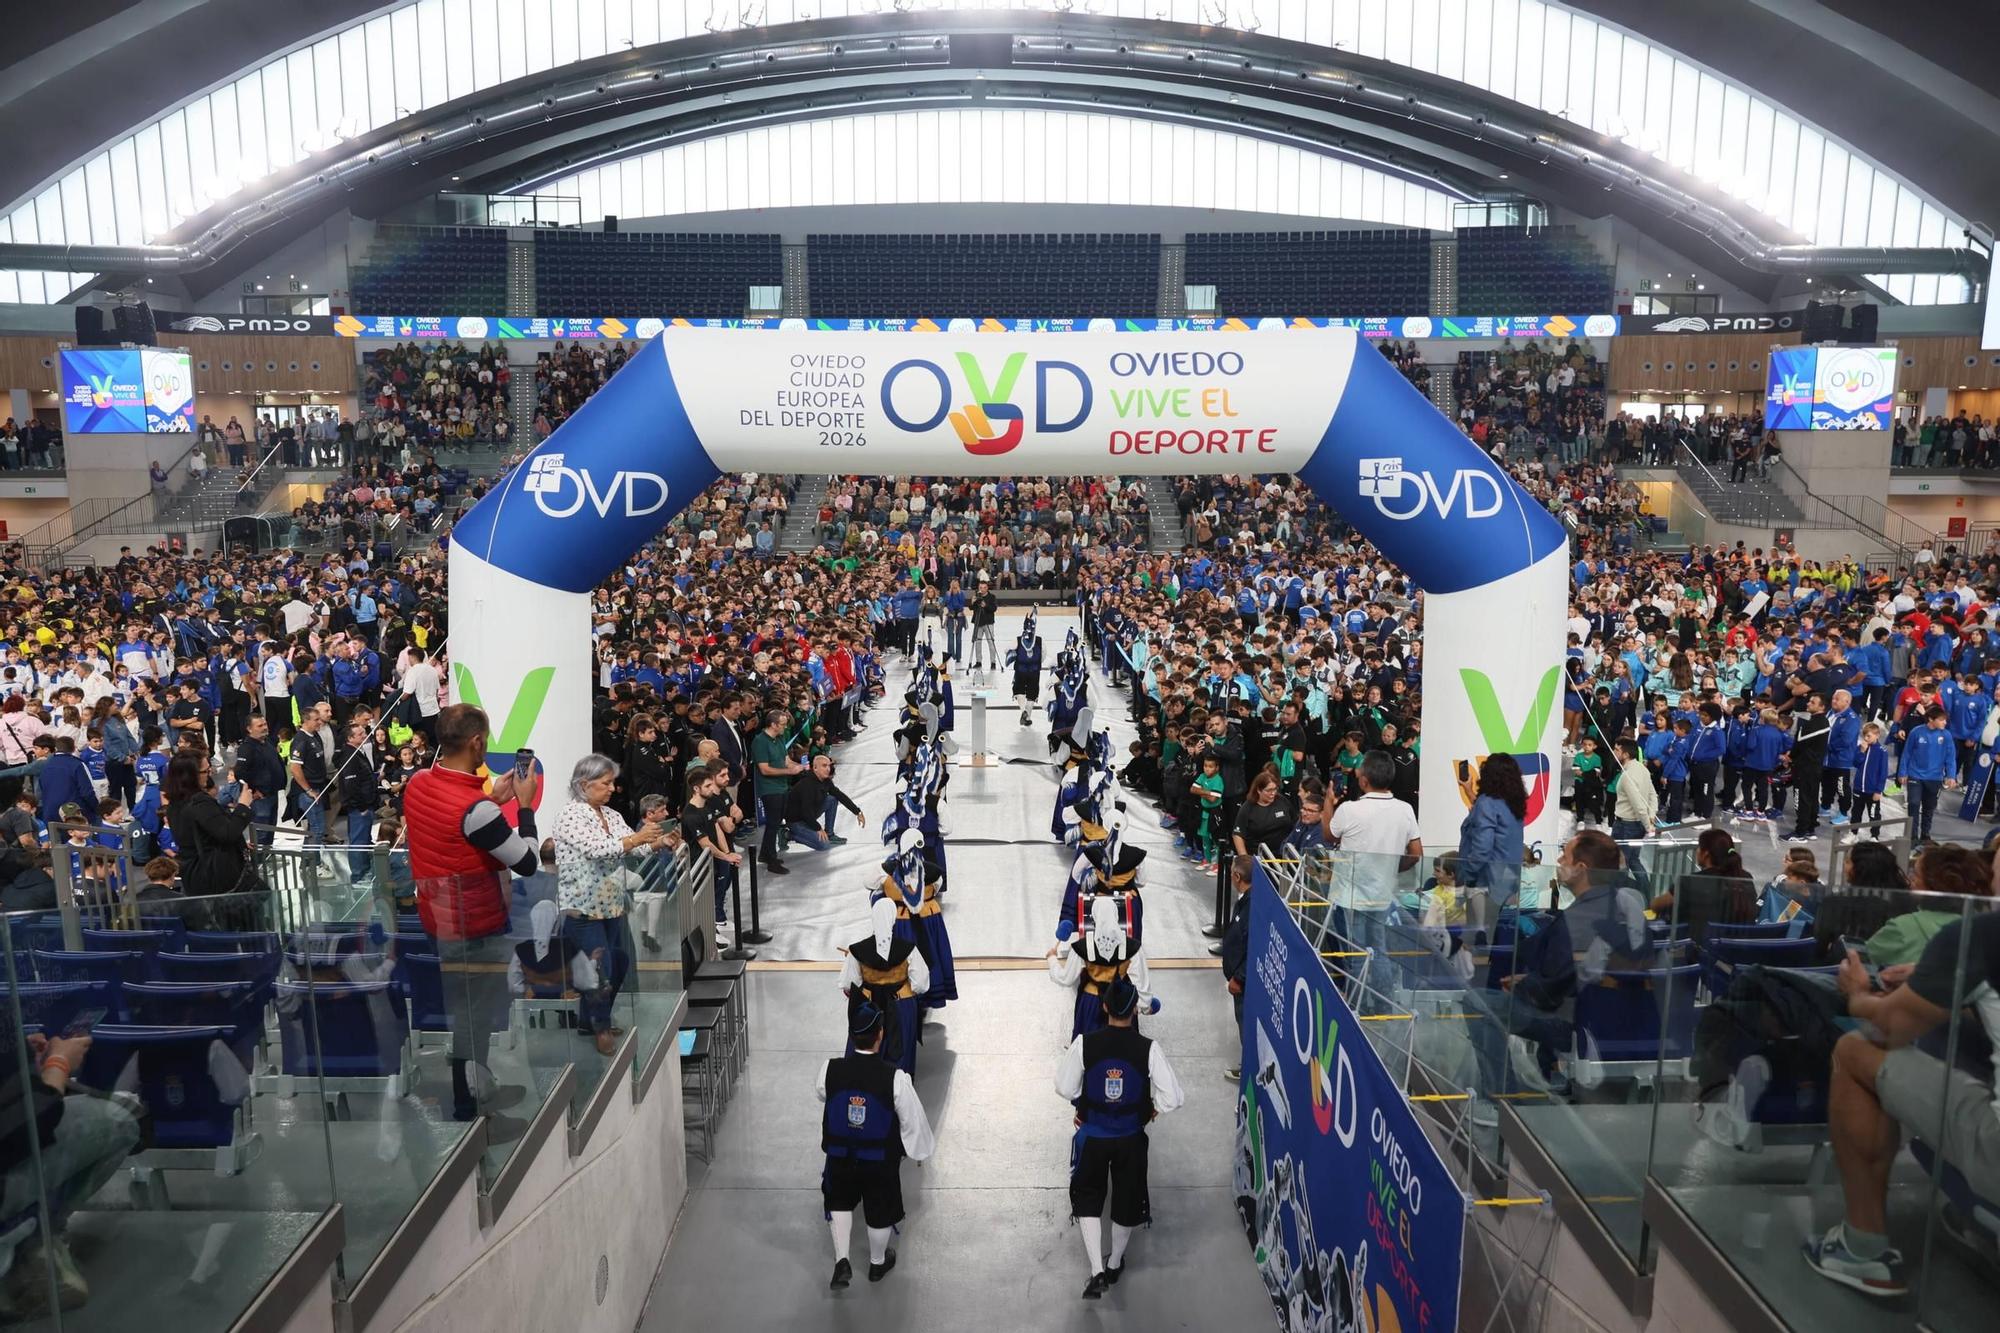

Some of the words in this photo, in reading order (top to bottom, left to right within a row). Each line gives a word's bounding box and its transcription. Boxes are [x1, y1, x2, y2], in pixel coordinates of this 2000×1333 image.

[790, 354, 866, 369] OVIEDO
[1110, 352, 1244, 376] OVIEDO
[790, 371, 865, 388] CIUDAD
[777, 391, 865, 408] EUROPEA
[881, 352, 1093, 454] OVD
[1110, 388, 1192, 418] VIVE
[1201, 388, 1239, 417] EL
[740, 410, 774, 426] DEL
[781, 411, 865, 428] DEPORTE
[819, 432, 867, 446] 2026
[1109, 429, 1278, 455] DEPORTE
[535, 467, 669, 518] OVD
[1374, 470, 1503, 520] OVD
[1270, 922, 1288, 962] OVIEDO
[1371, 1107, 1421, 1216] OVIEDO
[1368, 1149, 1397, 1227] VIVE
[1399, 1207, 1414, 1262] EL
